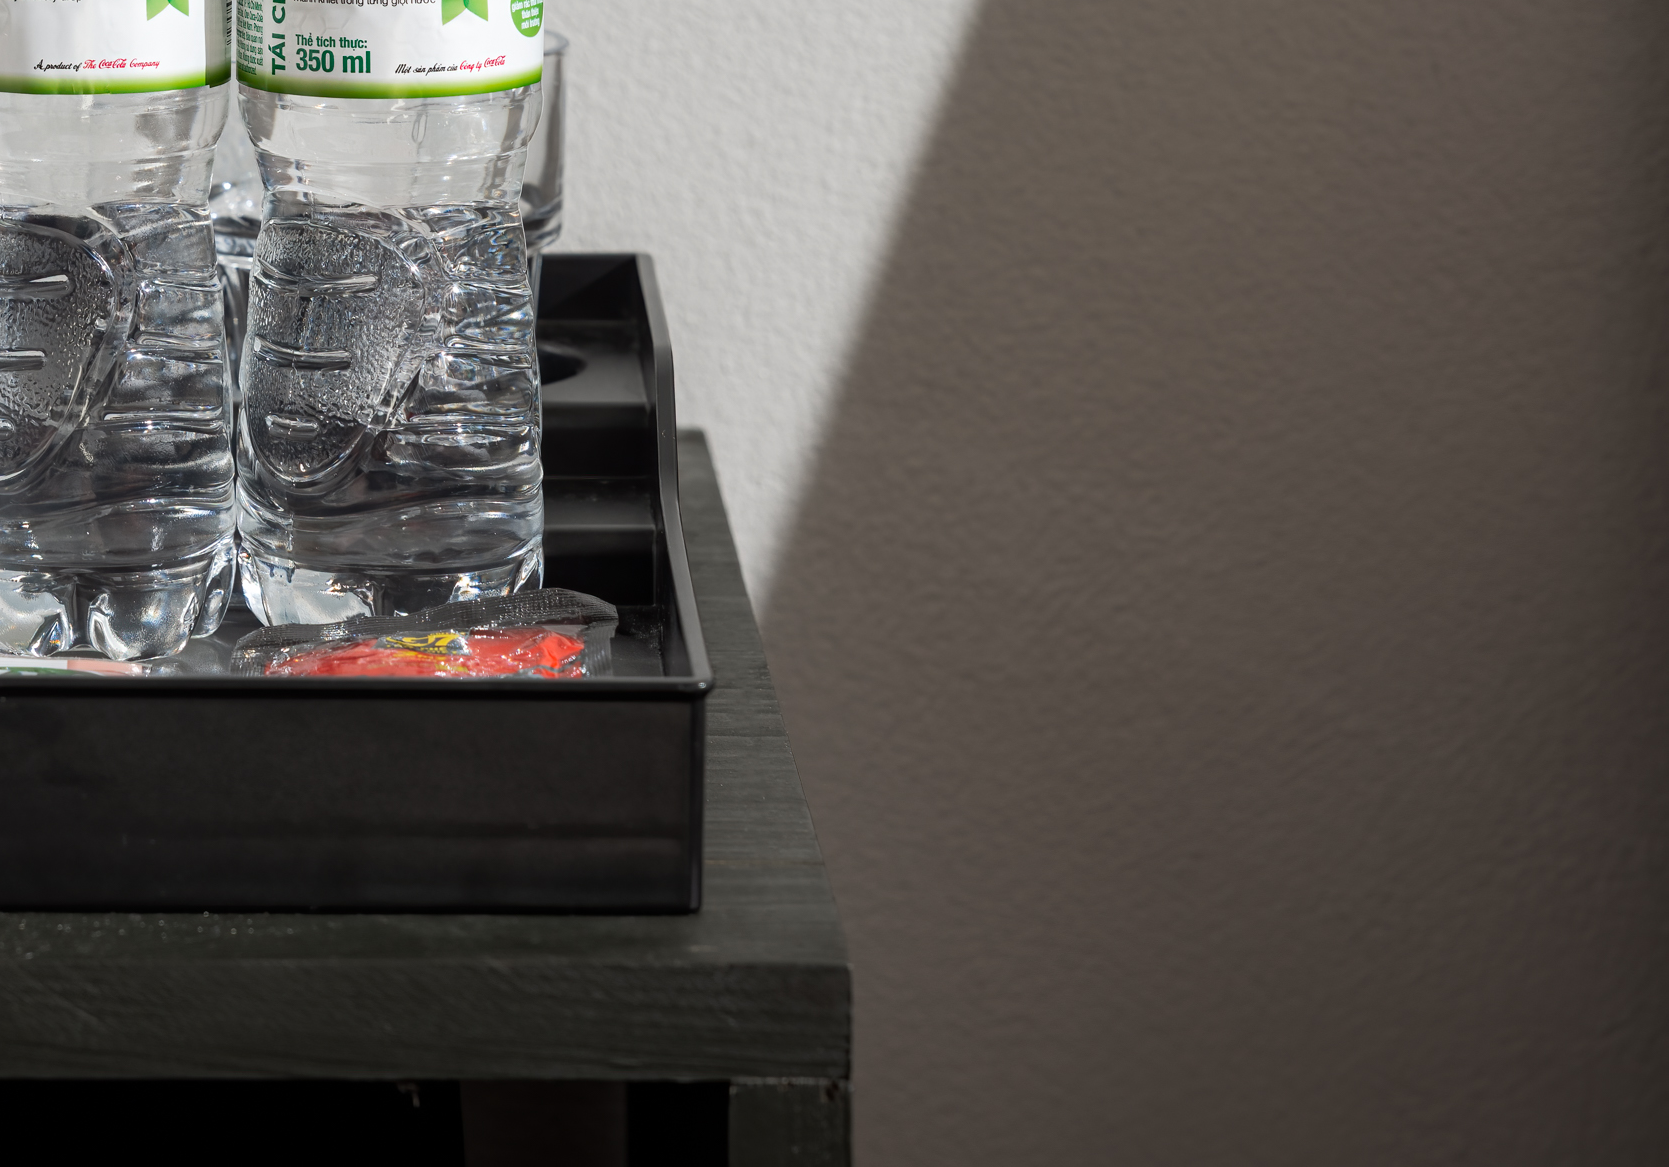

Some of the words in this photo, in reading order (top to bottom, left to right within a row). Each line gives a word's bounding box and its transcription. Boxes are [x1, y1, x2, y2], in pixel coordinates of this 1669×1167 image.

[296, 32, 314, 47] Thể
[316, 35, 337, 48] tích
[338, 36, 368, 51] thực:
[33, 58, 44, 70] A
[44, 61, 72, 72] product
[73, 62, 82, 72] of
[83, 59, 97, 69] The
[129, 58, 160, 70] Company
[268, 32, 286, 76] TÁI
[296, 48, 335, 73] 350
[342, 50, 371, 74] ml
